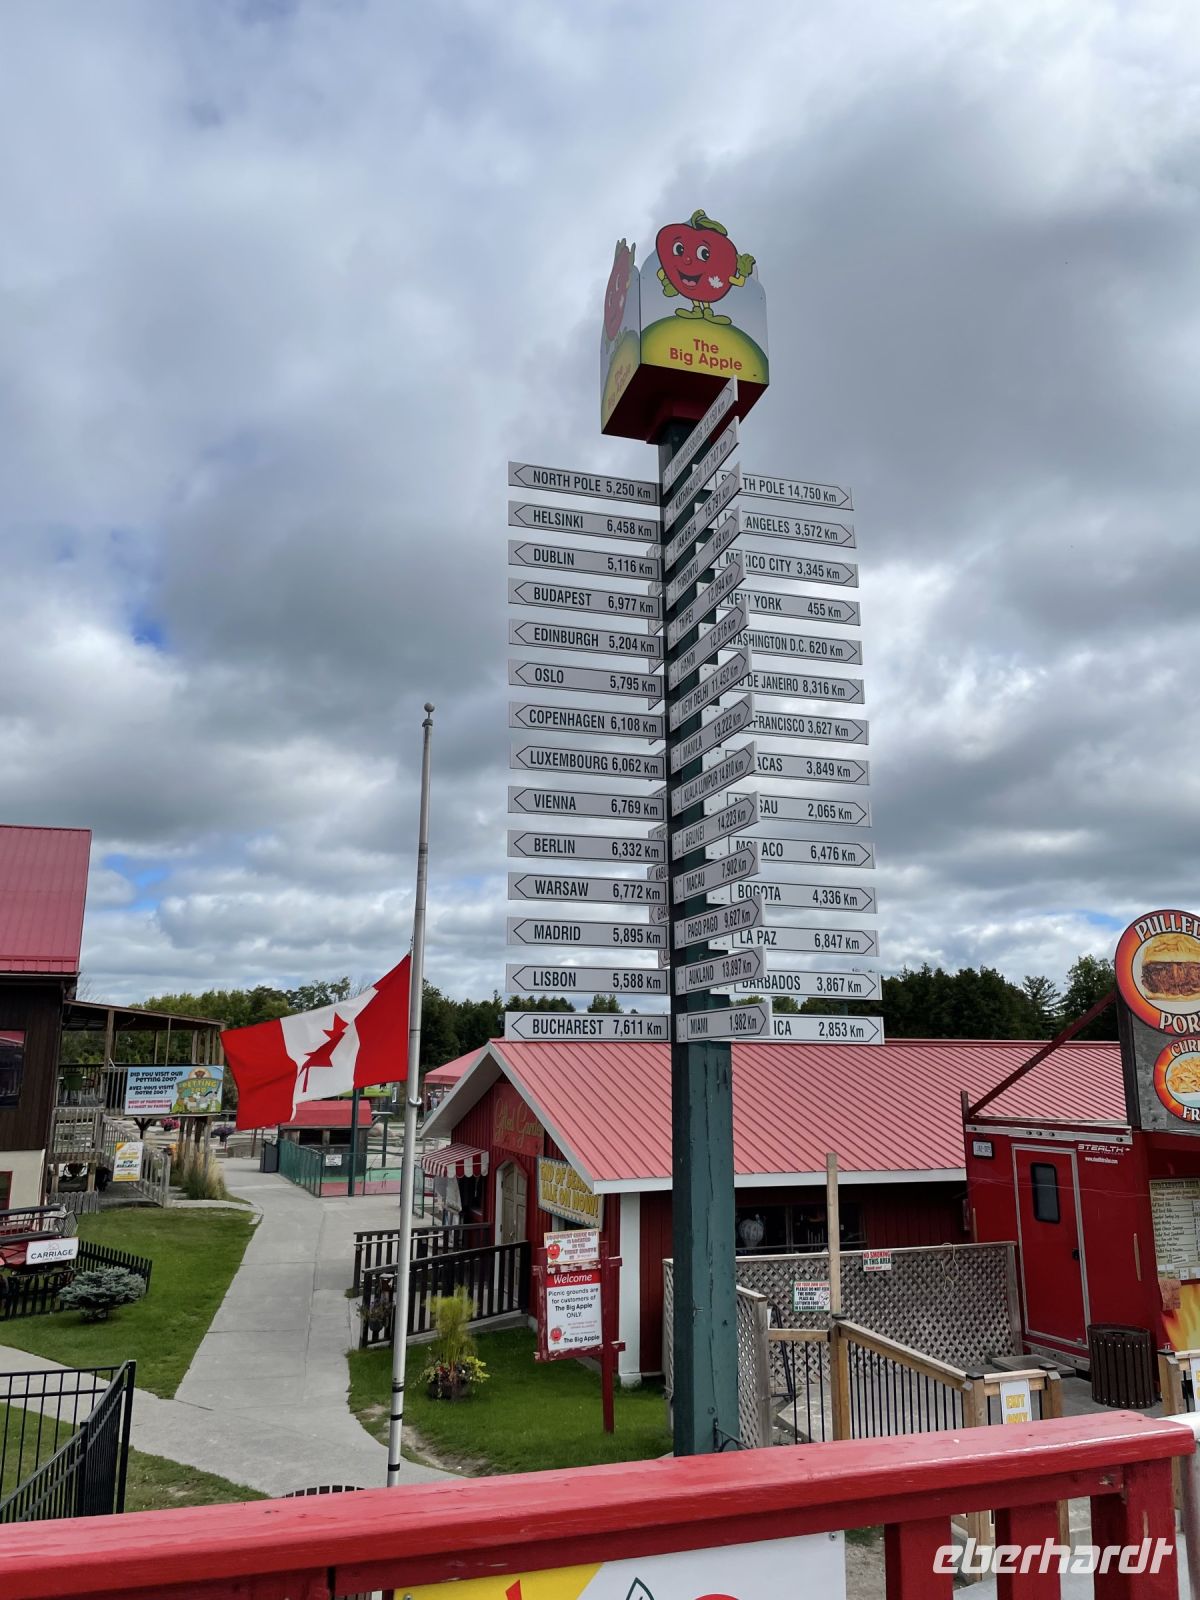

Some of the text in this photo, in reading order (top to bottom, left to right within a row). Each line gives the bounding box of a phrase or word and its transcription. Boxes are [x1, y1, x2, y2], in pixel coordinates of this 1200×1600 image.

[693, 338, 719, 353] The
[670, 347, 742, 370] Big Apple
[533, 470, 651, 498] NORTH POLE 5,250 Km
[759, 480, 837, 503] POLE 14,750 Km
[533, 510, 652, 537] HELSINKI 6,458 Km
[795, 523, 822, 538] 3,572
[825, 530, 838, 541] Km
[534, 548, 653, 575] DUBLIN 5,116 Km
[769, 557, 840, 580] CITY 3,345 Km
[534, 586, 654, 613] BUDAPEST 6,977 Km
[754, 596, 842, 618] YORK 455 Km
[534, 627, 655, 652] EDINBURGH 5,204 Km
[790, 640, 807, 653] D.C.
[809, 640, 828, 654] 620
[830, 646, 843, 656] Km
[534, 668, 656, 692] OSLO 5,795 Km
[748, 674, 759, 688] DE
[762, 676, 798, 692] JANEIRO
[802, 680, 829, 695] 8,316
[832, 686, 845, 696] Km
[694, 686, 708, 707] DELHI
[529, 709, 657, 733] COPENHAGEN 6,108 Km
[808, 720, 832, 735] 3,627
[835, 725, 849, 737] Km
[530, 750, 658, 774] LUXEMBOURG 6,062 Km
[806, 760, 851, 778] 3,849 Km
[534, 794, 658, 816] VIENNA 6,769 Km
[808, 803, 852, 820] 2,065 Km
[686, 825, 704, 848] BRUNEI
[718, 810, 736, 832] 14,223
[534, 838, 659, 858] BERLIN 6,332 Km
[810, 845, 856, 862] 6,476 Km
[534, 880, 660, 900] WARSAW 6,772 Km
[686, 871, 704, 892] MACAU
[812, 890, 841, 906] 4,336
[844, 894, 858, 906] Km
[688, 909, 750, 938] PAGO PAGO 9,627 Km
[534, 924, 661, 944] MADRID 5,895 Km
[740, 930, 860, 950] LA PAZ 6,847 Km
[533, 970, 661, 990] LISBON 5,588 Km
[688, 959, 752, 985] AUKLAND 13,897 Km
[816, 976, 845, 993] 3,867
[848, 981, 862, 993] Km
[532, 1018, 662, 1036] BUCHAREST 7,611 Km
[690, 1017, 708, 1034] MIAMI
[729, 1012, 746, 1032] 1,982
[748, 1016, 756, 1030] Km
[818, 1022, 864, 1038] 2,853 Km
[1160, 1012, 1200, 1034] POR
[1078, 1144, 1124, 1152] STEALTH
[30, 1248, 74, 1260] CARRIAGE
[554, 1274, 592, 1284] Welcome
[560, 1296, 590, 1304] customers
[566, 1288, 588, 1296] grounds
